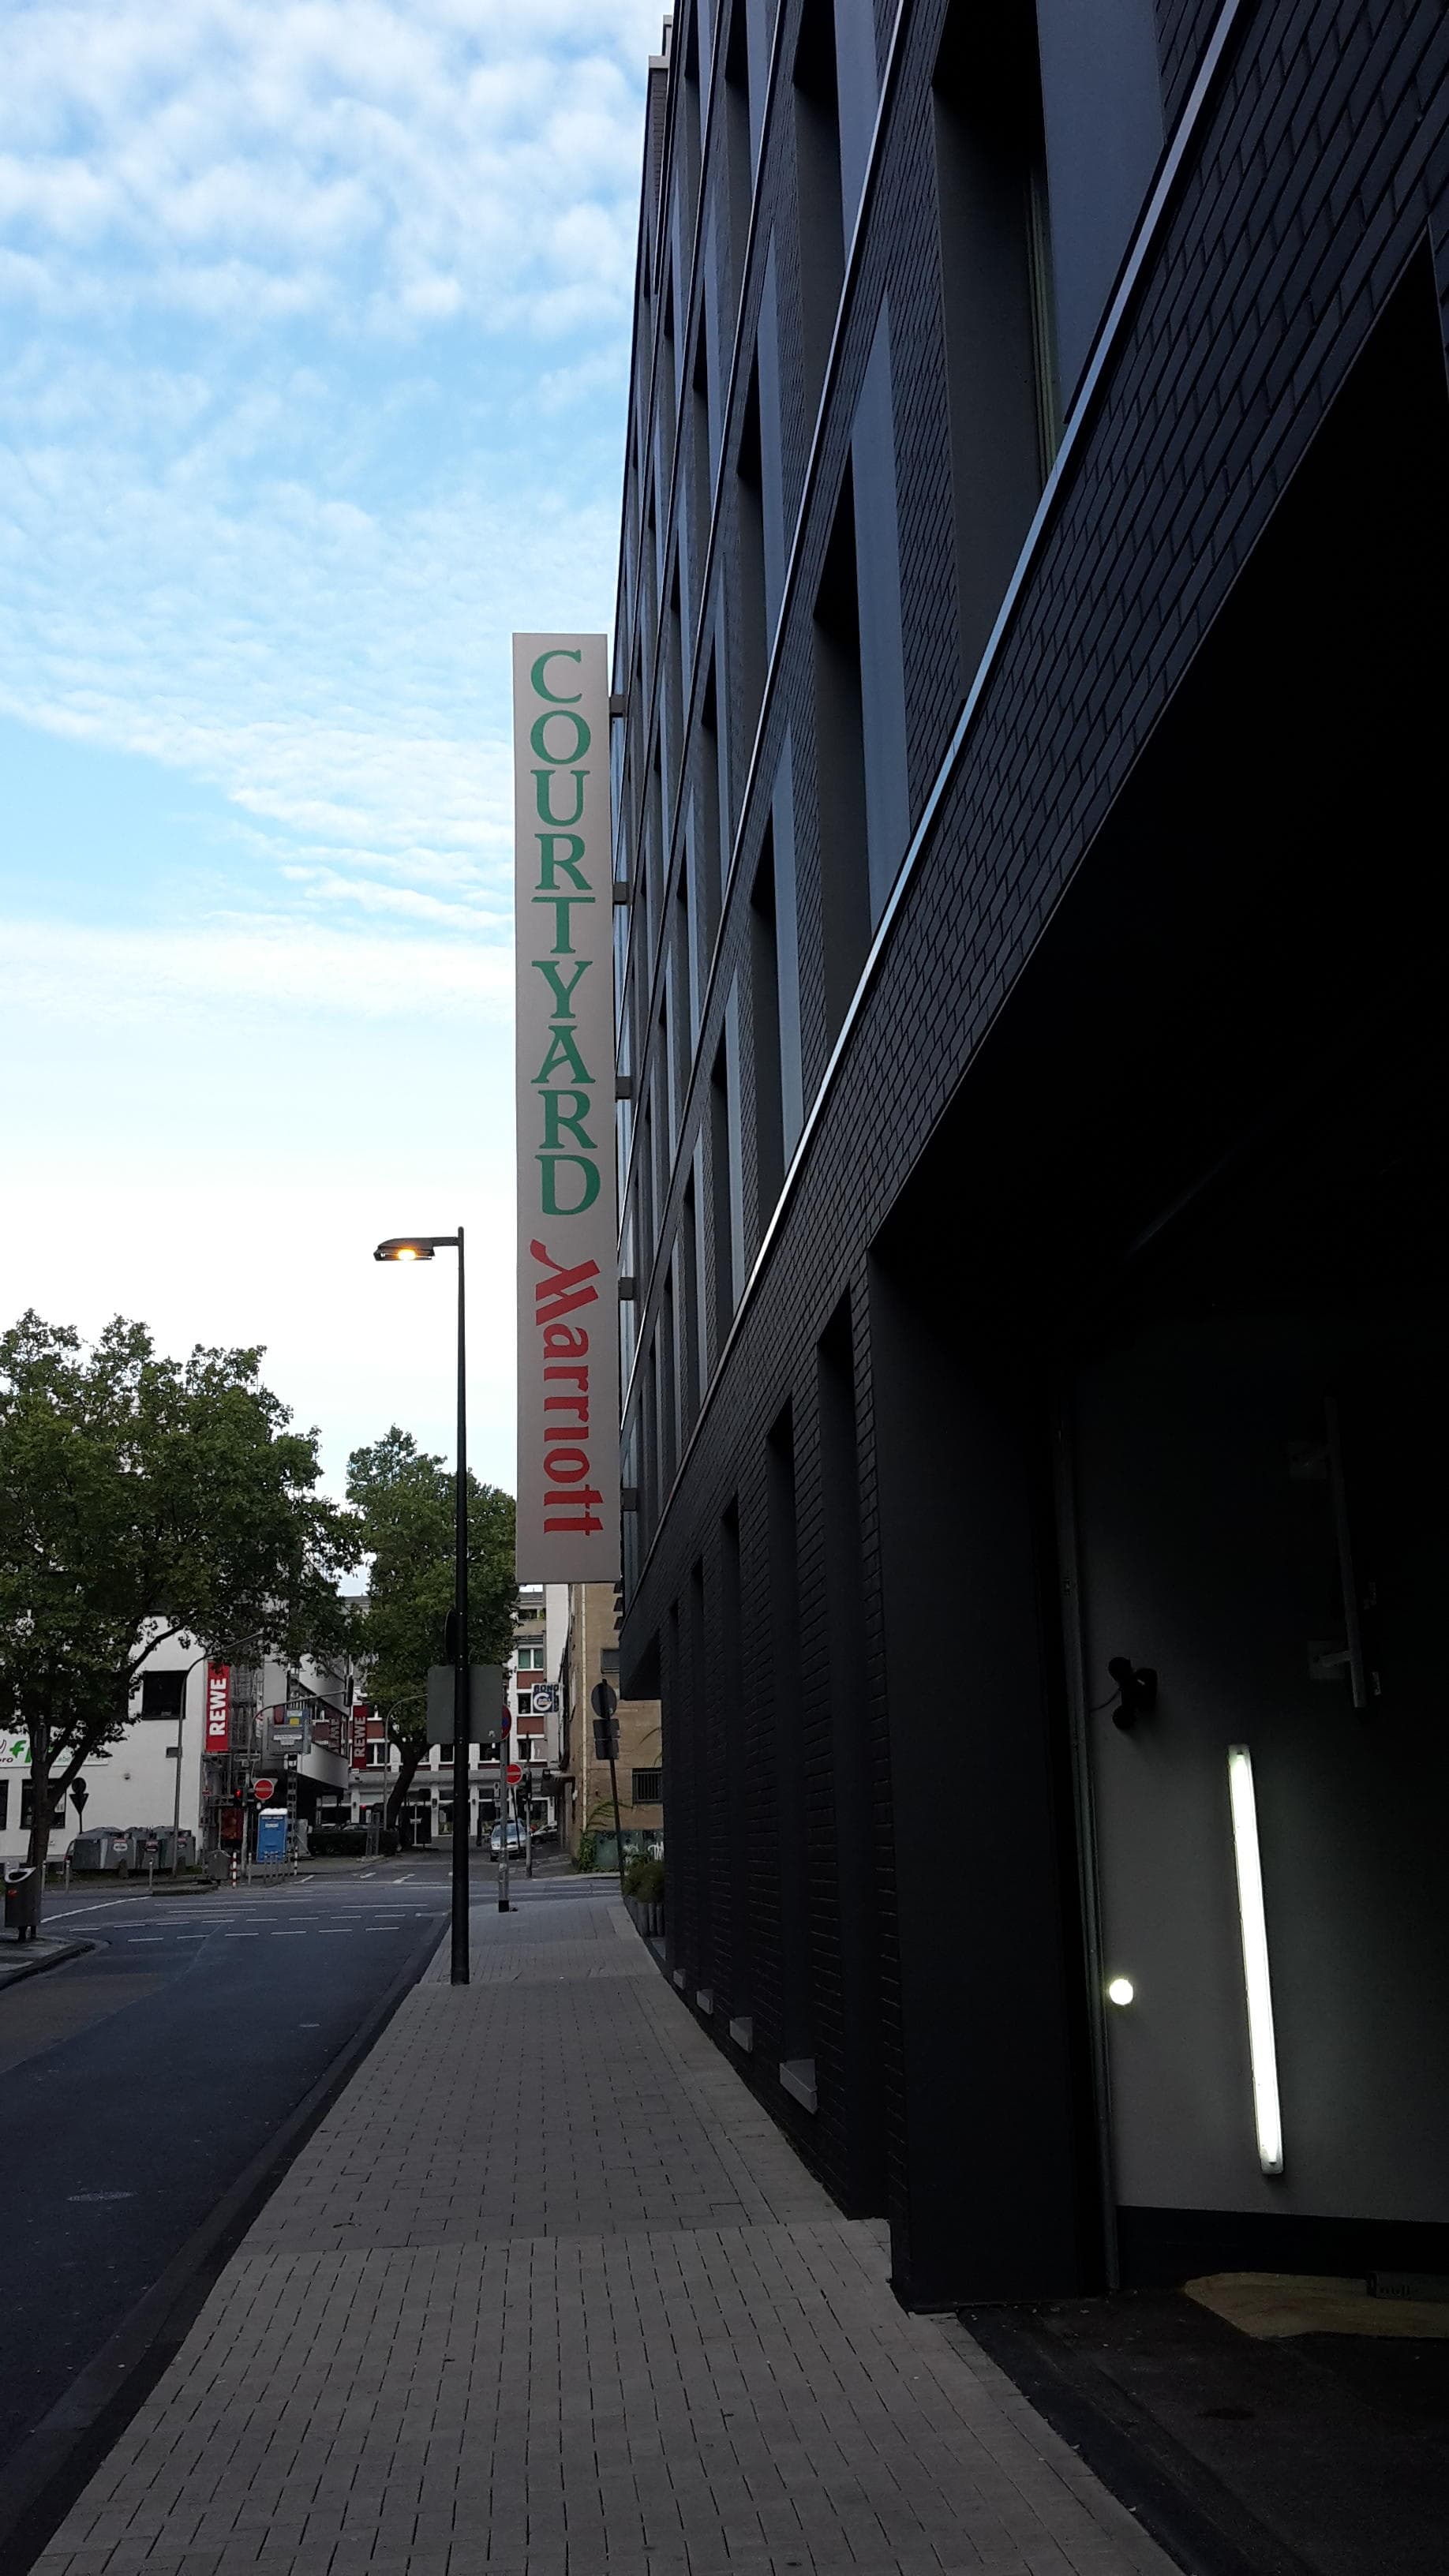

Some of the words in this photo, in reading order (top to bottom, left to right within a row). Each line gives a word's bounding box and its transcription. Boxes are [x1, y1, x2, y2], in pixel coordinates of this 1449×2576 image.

[530, 650, 601, 1216] COURTYARD
[530, 1239, 604, 1536] Marriott
[209, 1678, 227, 1735] REWE
[354, 1716, 365, 1758] REWE
